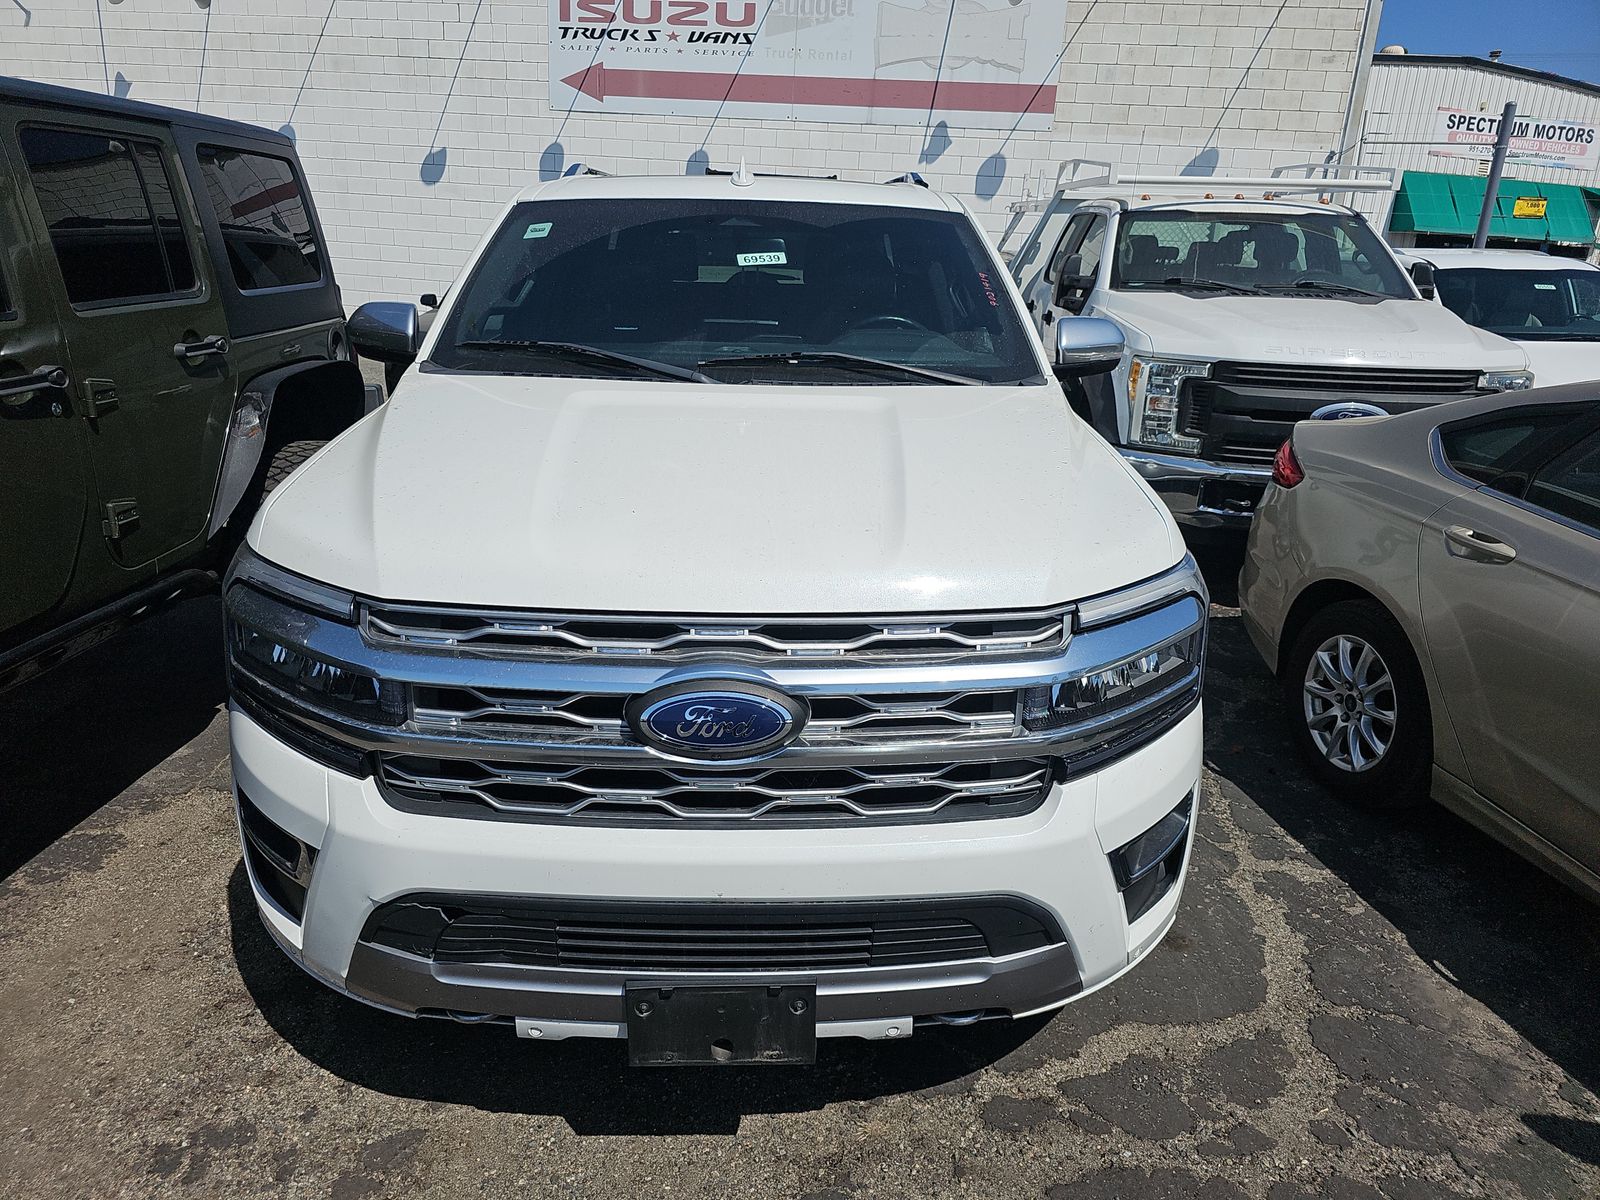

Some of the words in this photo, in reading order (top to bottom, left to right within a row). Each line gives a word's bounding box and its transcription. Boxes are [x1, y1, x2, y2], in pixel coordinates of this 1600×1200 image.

[559, 0, 757, 27] ISUZU
[558, 26, 661, 42] TRUCKS
[687, 31, 757, 45] VANS
[560, 43, 601, 52] SALES
[626, 46, 669, 54] PARTS
[693, 48, 756, 57] SERVICE
[764, 47, 801, 59] Truck
[808, 49, 853, 61] Rental
[1446, 113, 1530, 137] SPECTUM
[1533, 122, 1595, 144] MOTORS
[1456, 133, 1493, 143] QUALITY
[1541, 142, 1581, 154] VEHICLES
[743, 254, 781, 264] 69539
[676, 705, 757, 738] Ford
